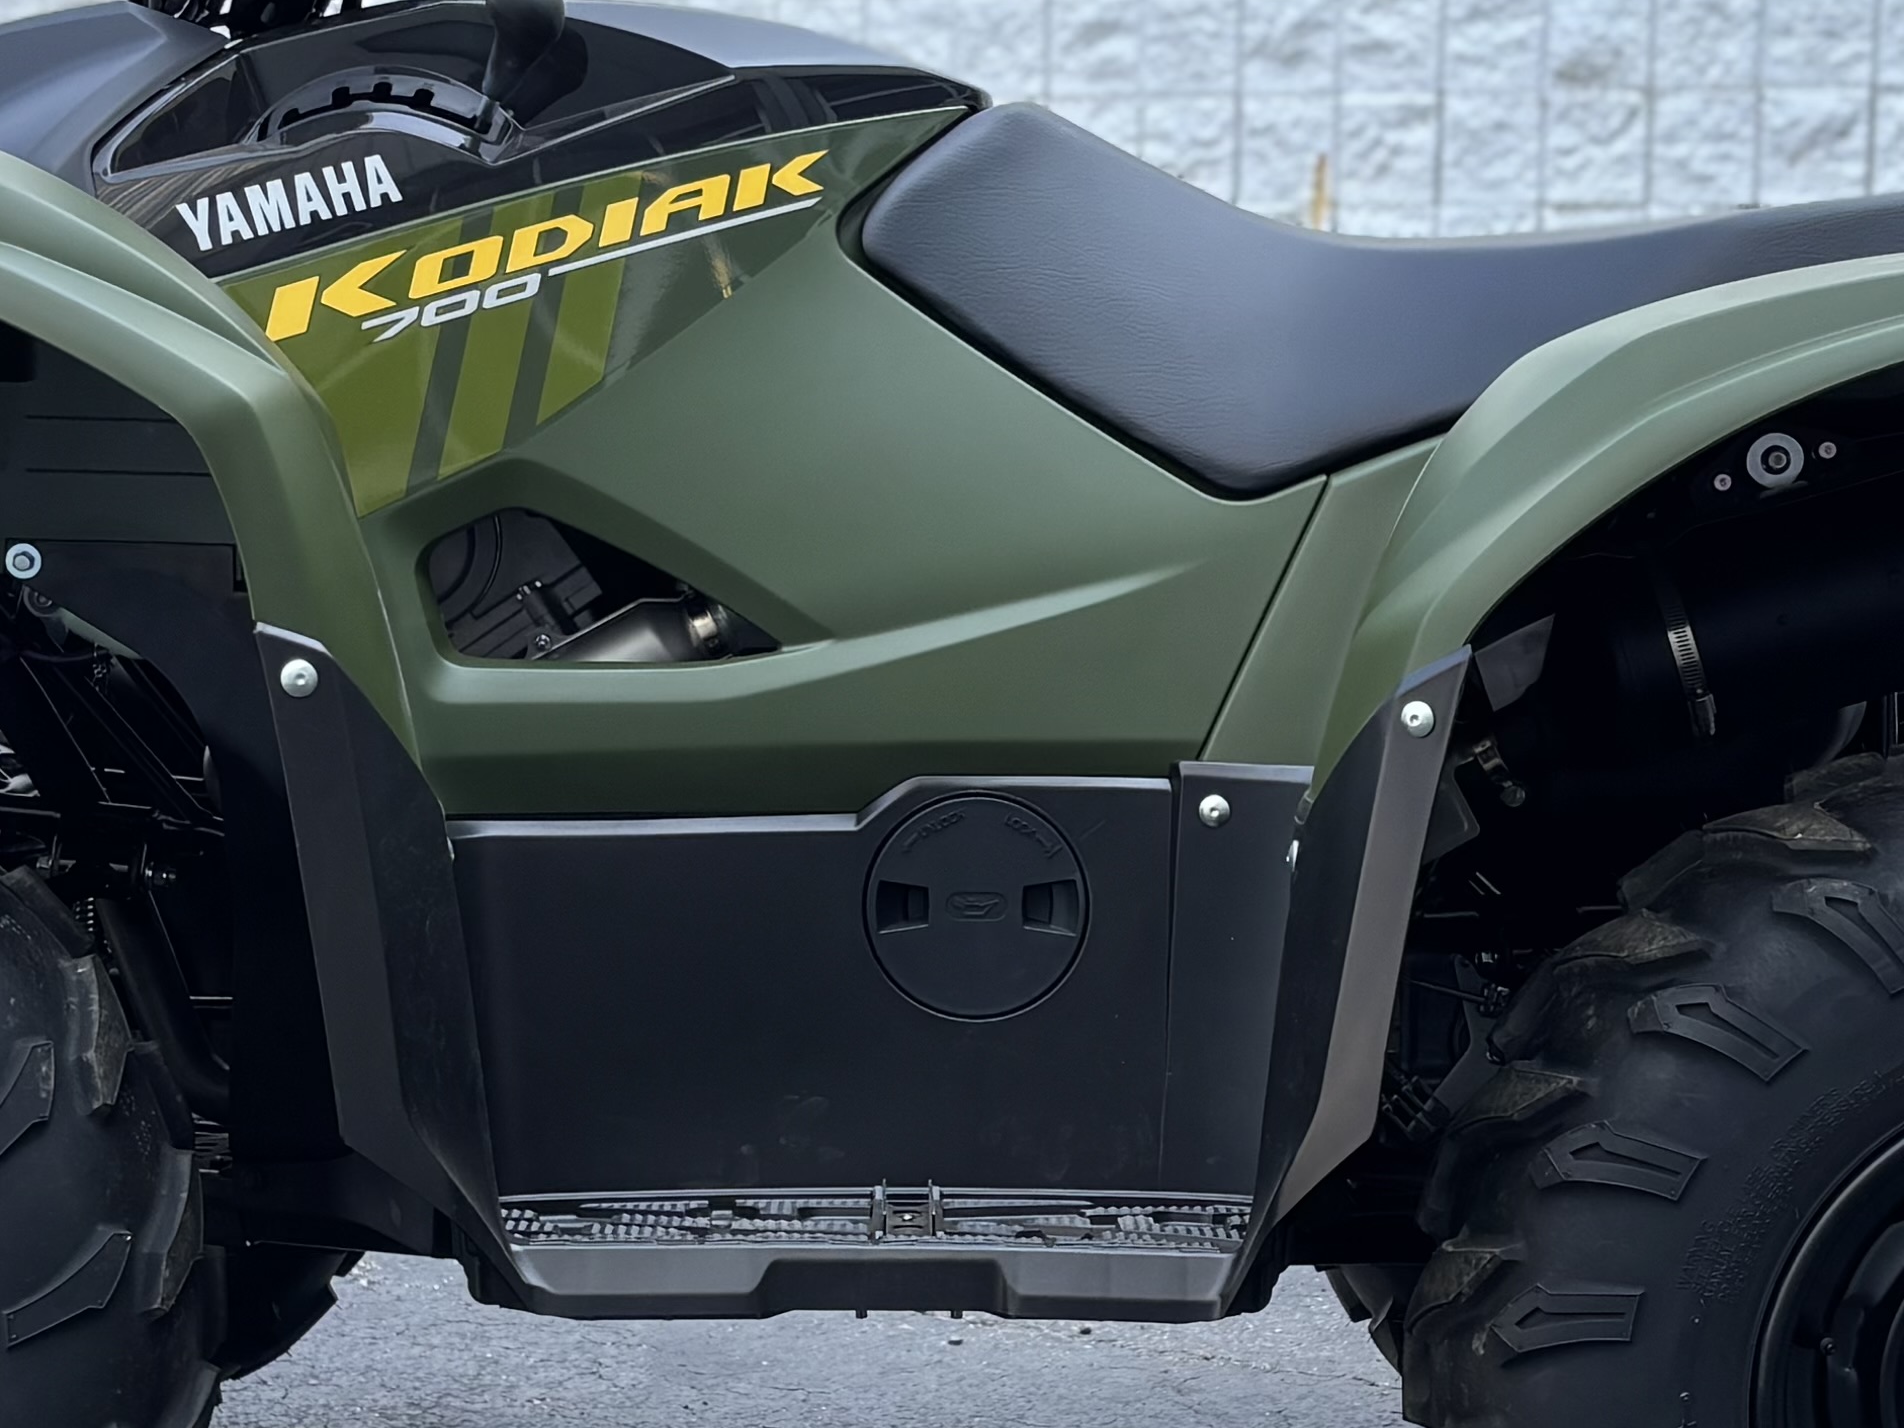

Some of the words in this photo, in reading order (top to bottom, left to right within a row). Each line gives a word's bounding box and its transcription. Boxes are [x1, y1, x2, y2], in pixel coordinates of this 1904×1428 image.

[176, 154, 403, 251] YAMAHA
[266, 150, 829, 342] KODIAK
[362, 273, 541, 342] 700
